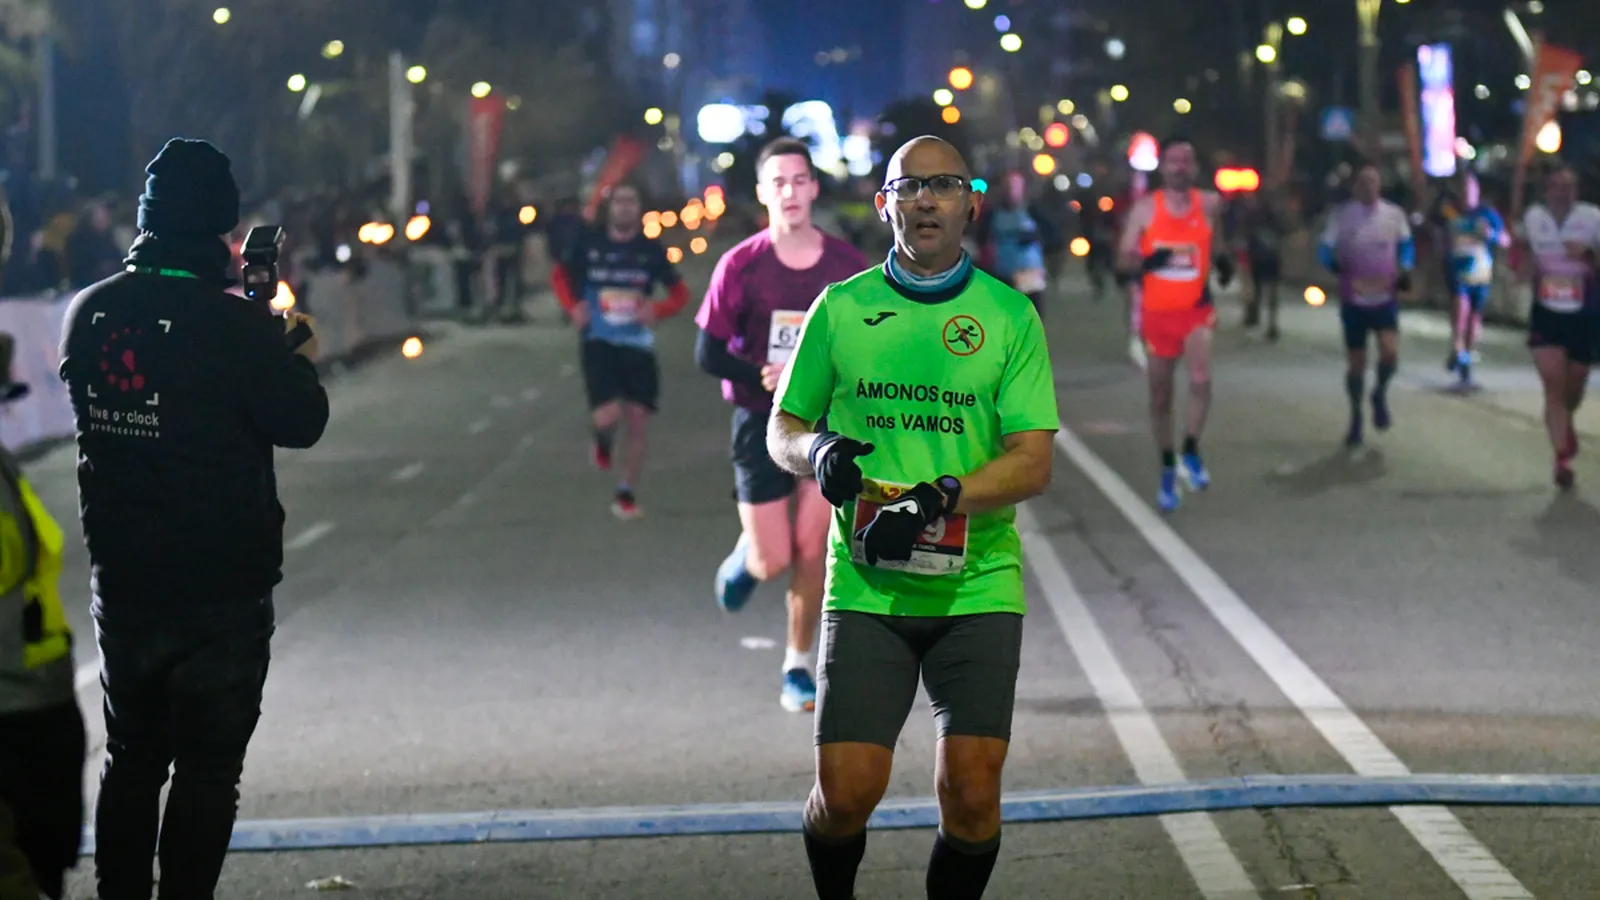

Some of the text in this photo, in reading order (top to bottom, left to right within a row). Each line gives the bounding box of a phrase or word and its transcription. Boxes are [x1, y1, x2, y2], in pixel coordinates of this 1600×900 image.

[856, 379, 976, 408] ÁMONOS que
[89, 404, 108, 420] five
[866, 413, 964, 435] nos VAMOS
